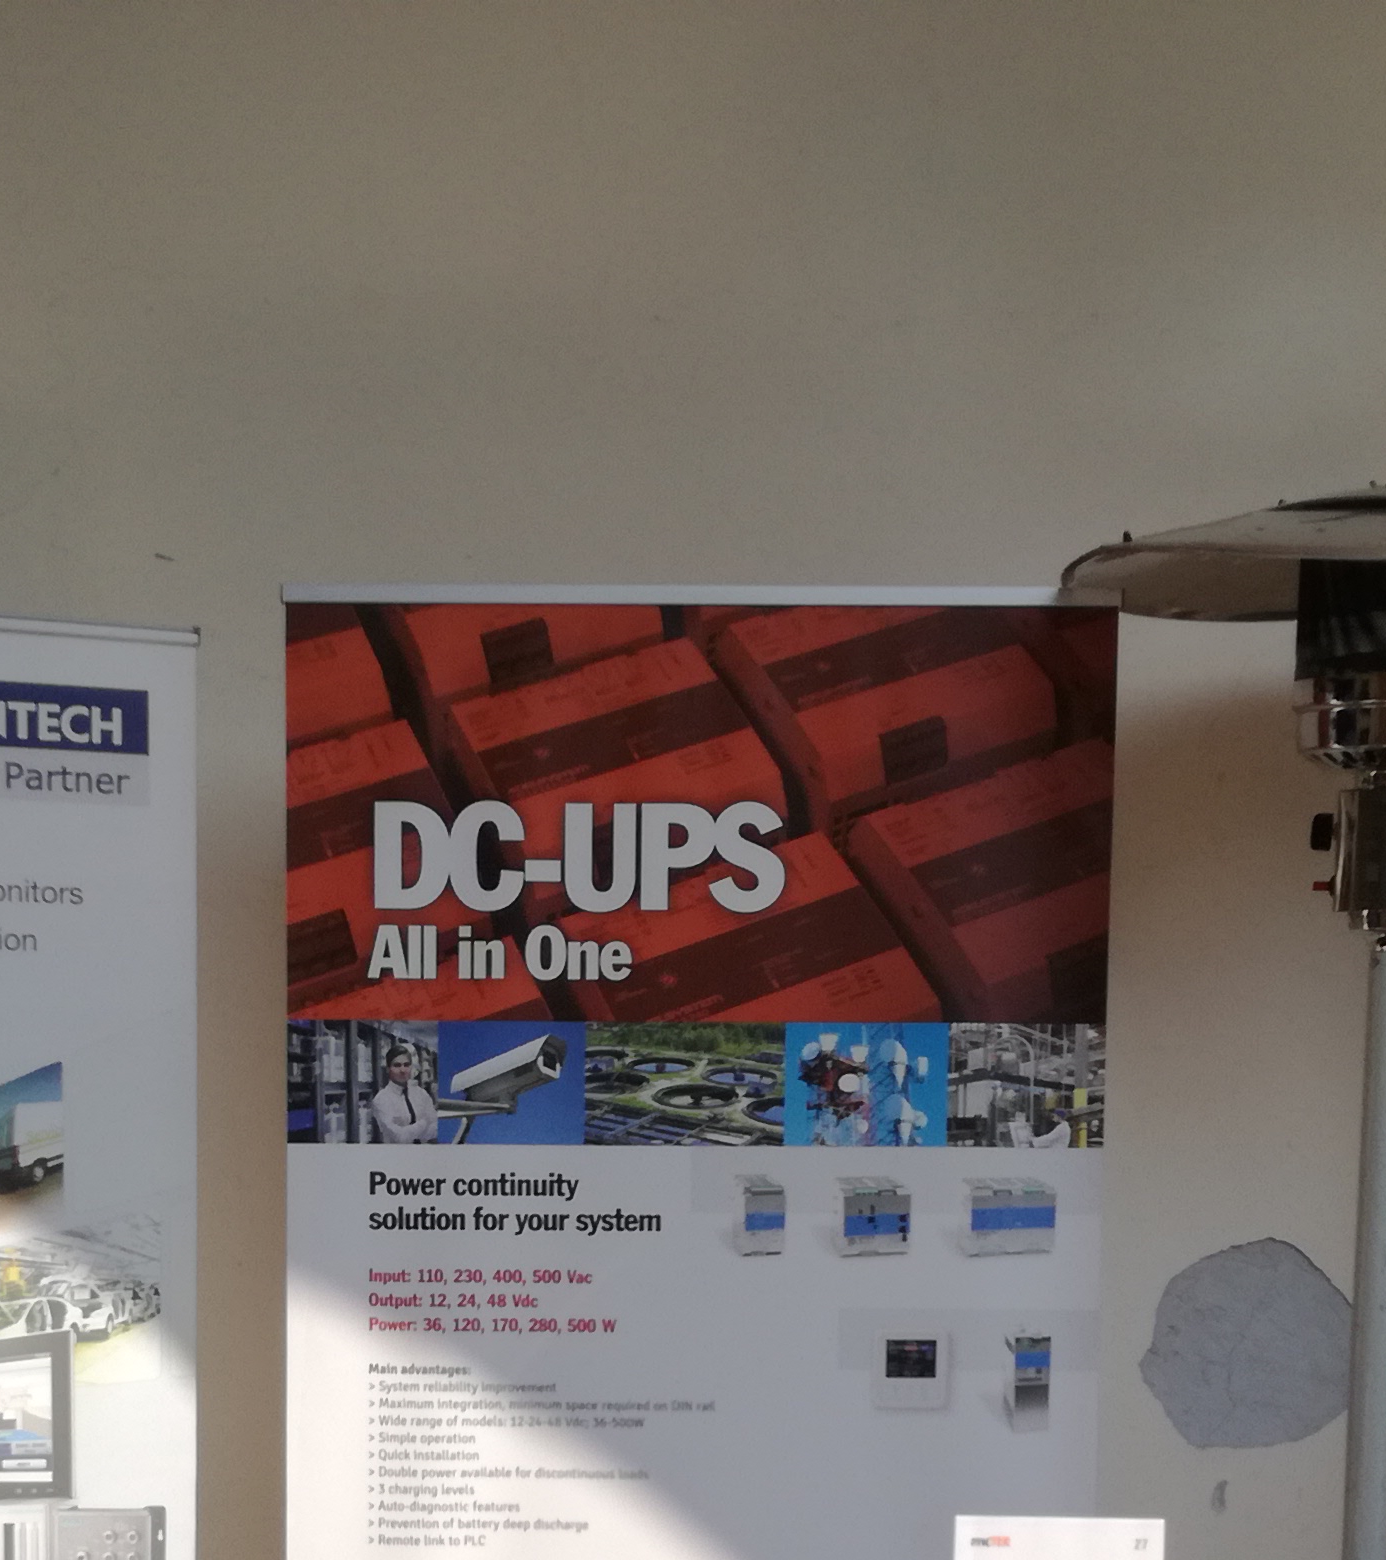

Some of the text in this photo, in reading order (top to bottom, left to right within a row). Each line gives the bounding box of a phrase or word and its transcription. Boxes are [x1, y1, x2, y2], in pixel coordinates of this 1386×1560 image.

[4, 759, 131, 796] Partner
[373, 800, 786, 913] DC-UPS
[367, 924, 633, 982] All in One
[369, 1171, 579, 1201] Power continuity
[369, 1207, 662, 1236] solution for your system
[369, 1268, 592, 1286] Input: 110, 230, 400, 500 Vac
[369, 1293, 538, 1310] Output: 12, 24, 48 Vdc
[369, 1317, 617, 1334] Power: 36, 120, 170, 280, 500 W
[368, 1363, 471, 1377] Main advantages:
[379, 1381, 556, 1394] System reliability improvement
[379, 1415, 458, 1430] Wide range of
[379, 1433, 475, 1446] Simple operation
[379, 1450, 479, 1462] Quick installation
[379, 1467, 456, 1481] Double power
[388, 1484, 474, 1497] charging levels
